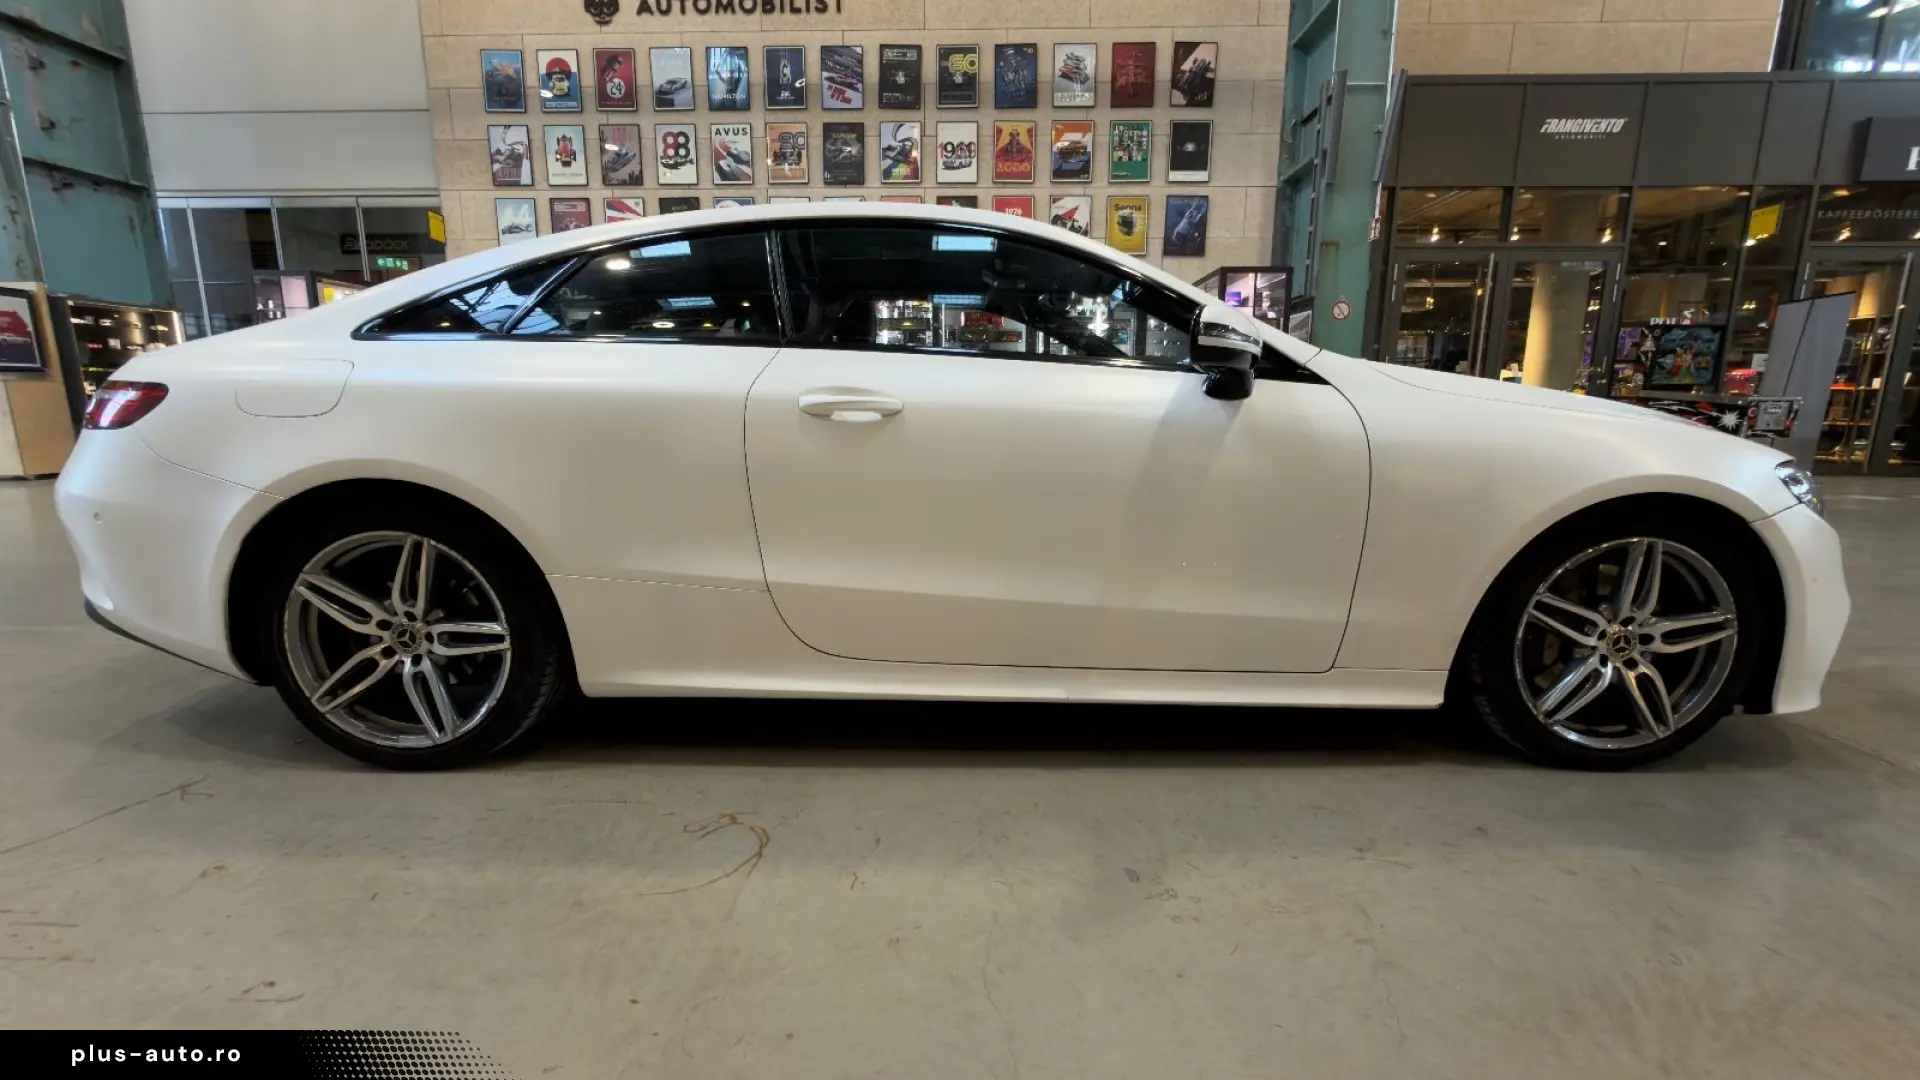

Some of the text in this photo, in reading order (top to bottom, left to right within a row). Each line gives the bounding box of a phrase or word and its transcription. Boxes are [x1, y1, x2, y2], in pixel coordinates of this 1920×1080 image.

[636, 0, 844, 16] AUTOMOBILIST
[714, 127, 748, 136] AVUS
[1541, 118, 1625, 133] FRANGIVENTO
[662, 131, 691, 159] 88
[1114, 203, 1142, 212] Senna
